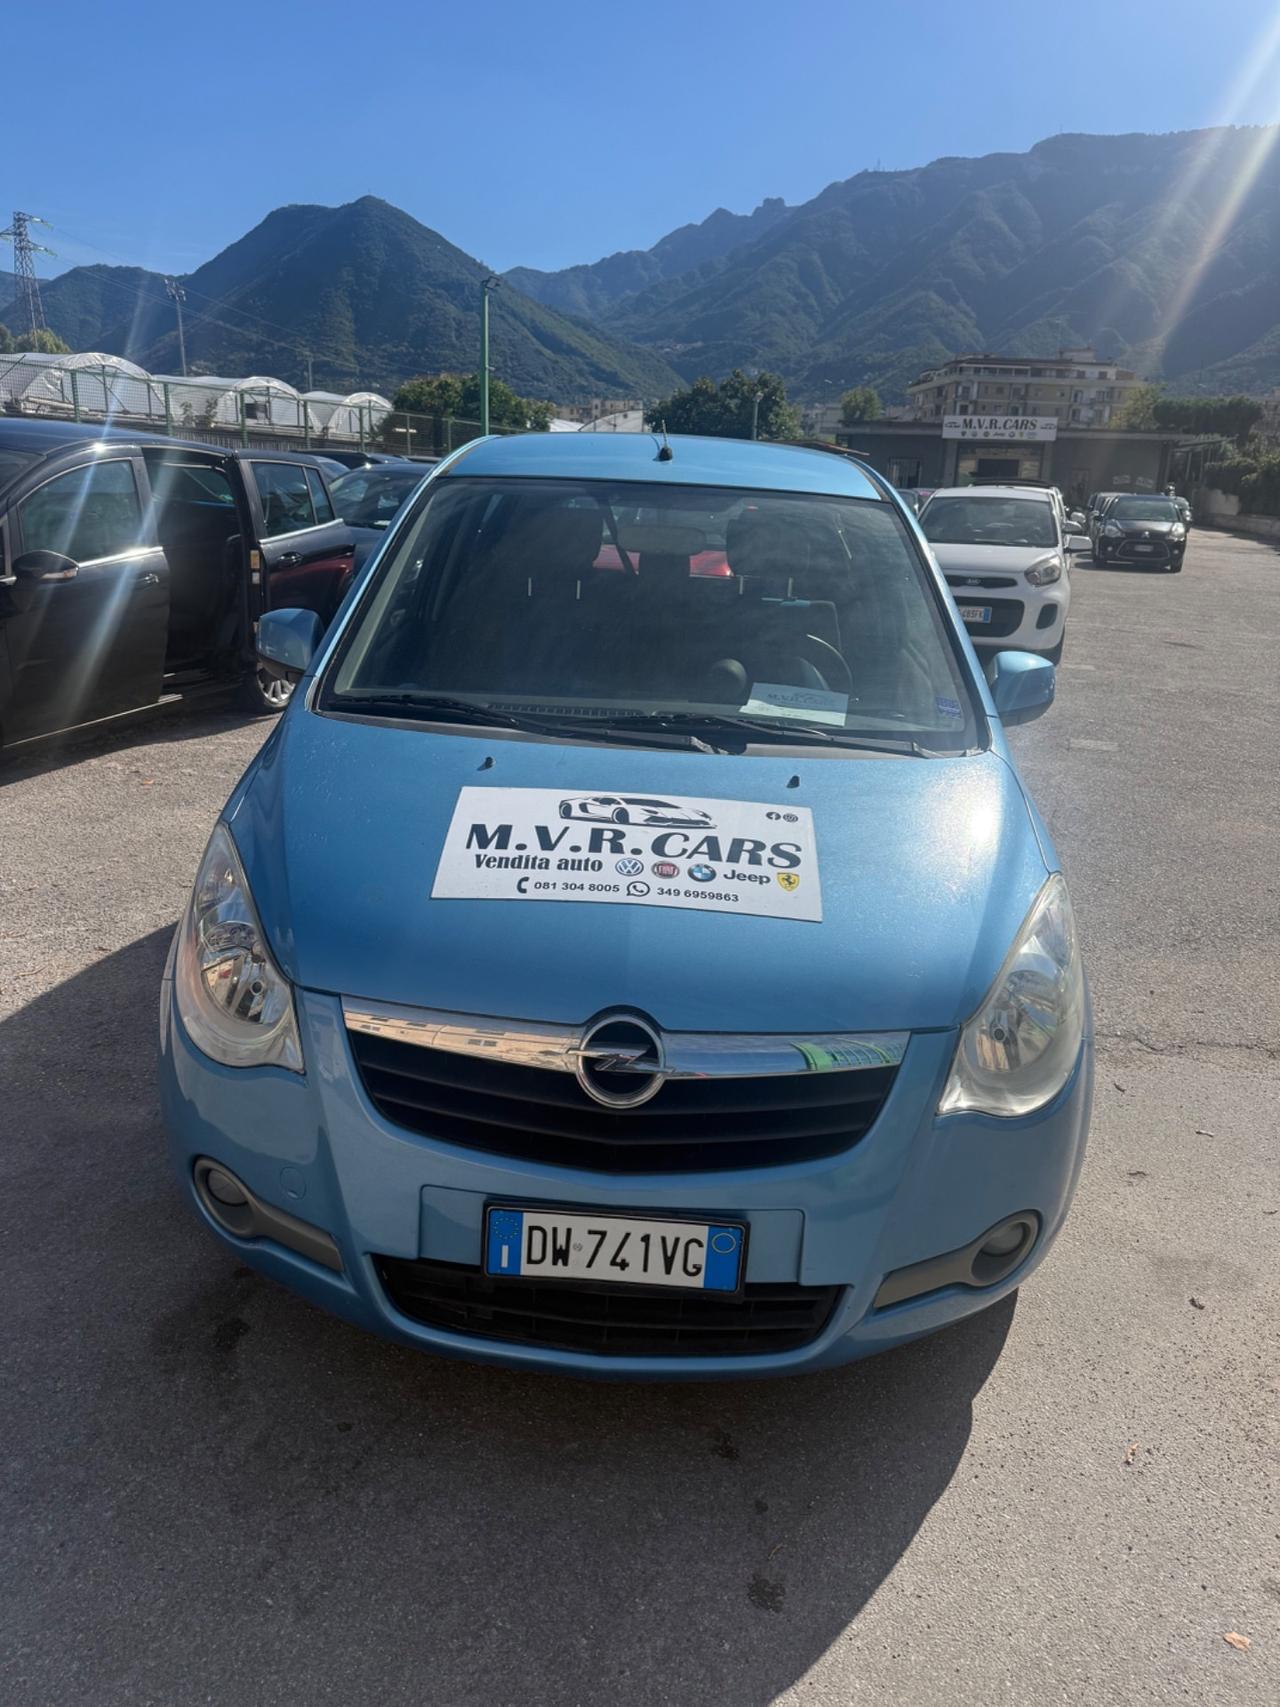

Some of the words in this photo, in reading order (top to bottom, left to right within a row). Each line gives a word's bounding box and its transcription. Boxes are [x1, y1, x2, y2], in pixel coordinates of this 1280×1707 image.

[474, 853, 551, 871] Vendita
[556, 855, 603, 873] auto
[722, 868, 771, 886] Jeep
[533, 881, 558, 891] 081
[561, 882, 585, 892] 304
[588, 882, 620, 893] 8005
[656, 886, 681, 898] 349
[683, 887, 739, 902] 6959863
